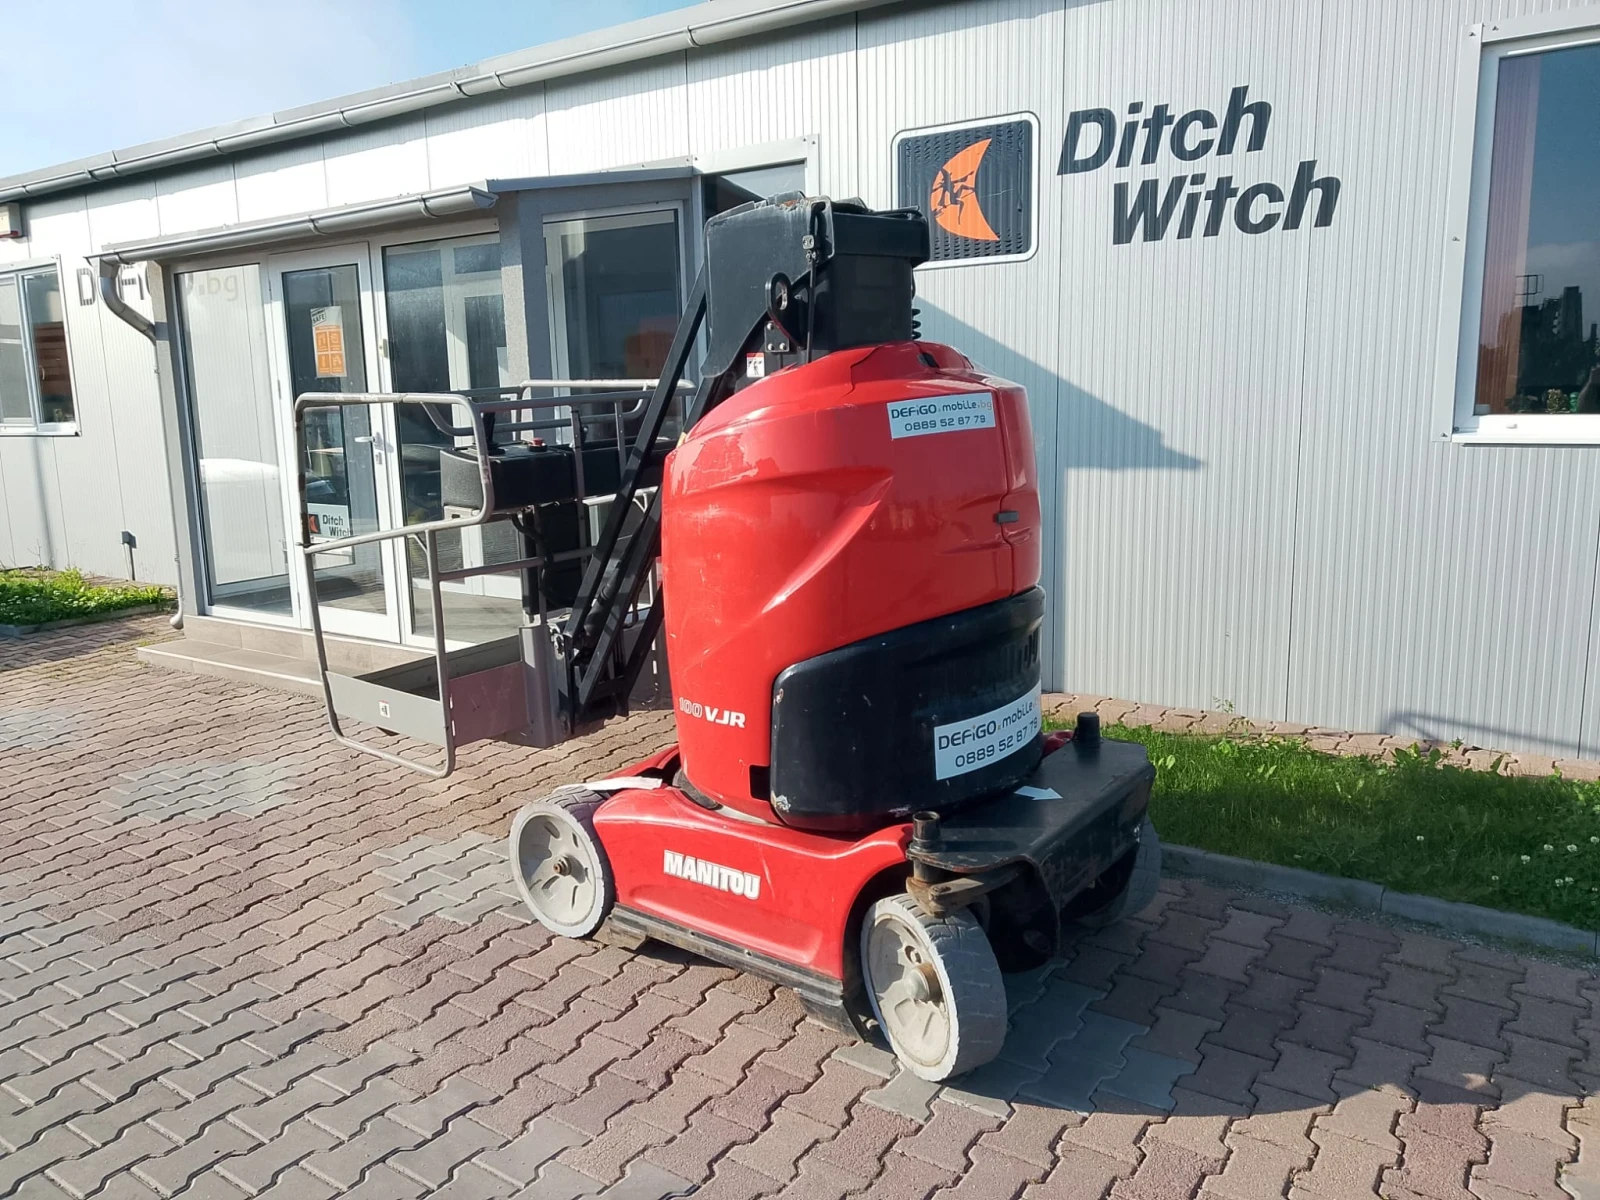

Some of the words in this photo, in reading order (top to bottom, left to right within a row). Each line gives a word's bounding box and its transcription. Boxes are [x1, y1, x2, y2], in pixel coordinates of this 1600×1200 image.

[1056, 85, 1272, 176] Ditch
[1112, 159, 1341, 245] Witch
[904, 419, 937, 432] 0889
[940, 418, 955, 428] 52
[958, 416, 971, 425] 87
[974, 414, 986, 424] 79
[322, 514, 344, 526] Ditch
[679, 697, 703, 718] 100
[704, 705, 746, 728] VJR
[955, 744, 996, 768] 0889
[999, 735, 1014, 752] 52
[1016, 726, 1028, 743] 87
[663, 849, 761, 900] MANITOU
